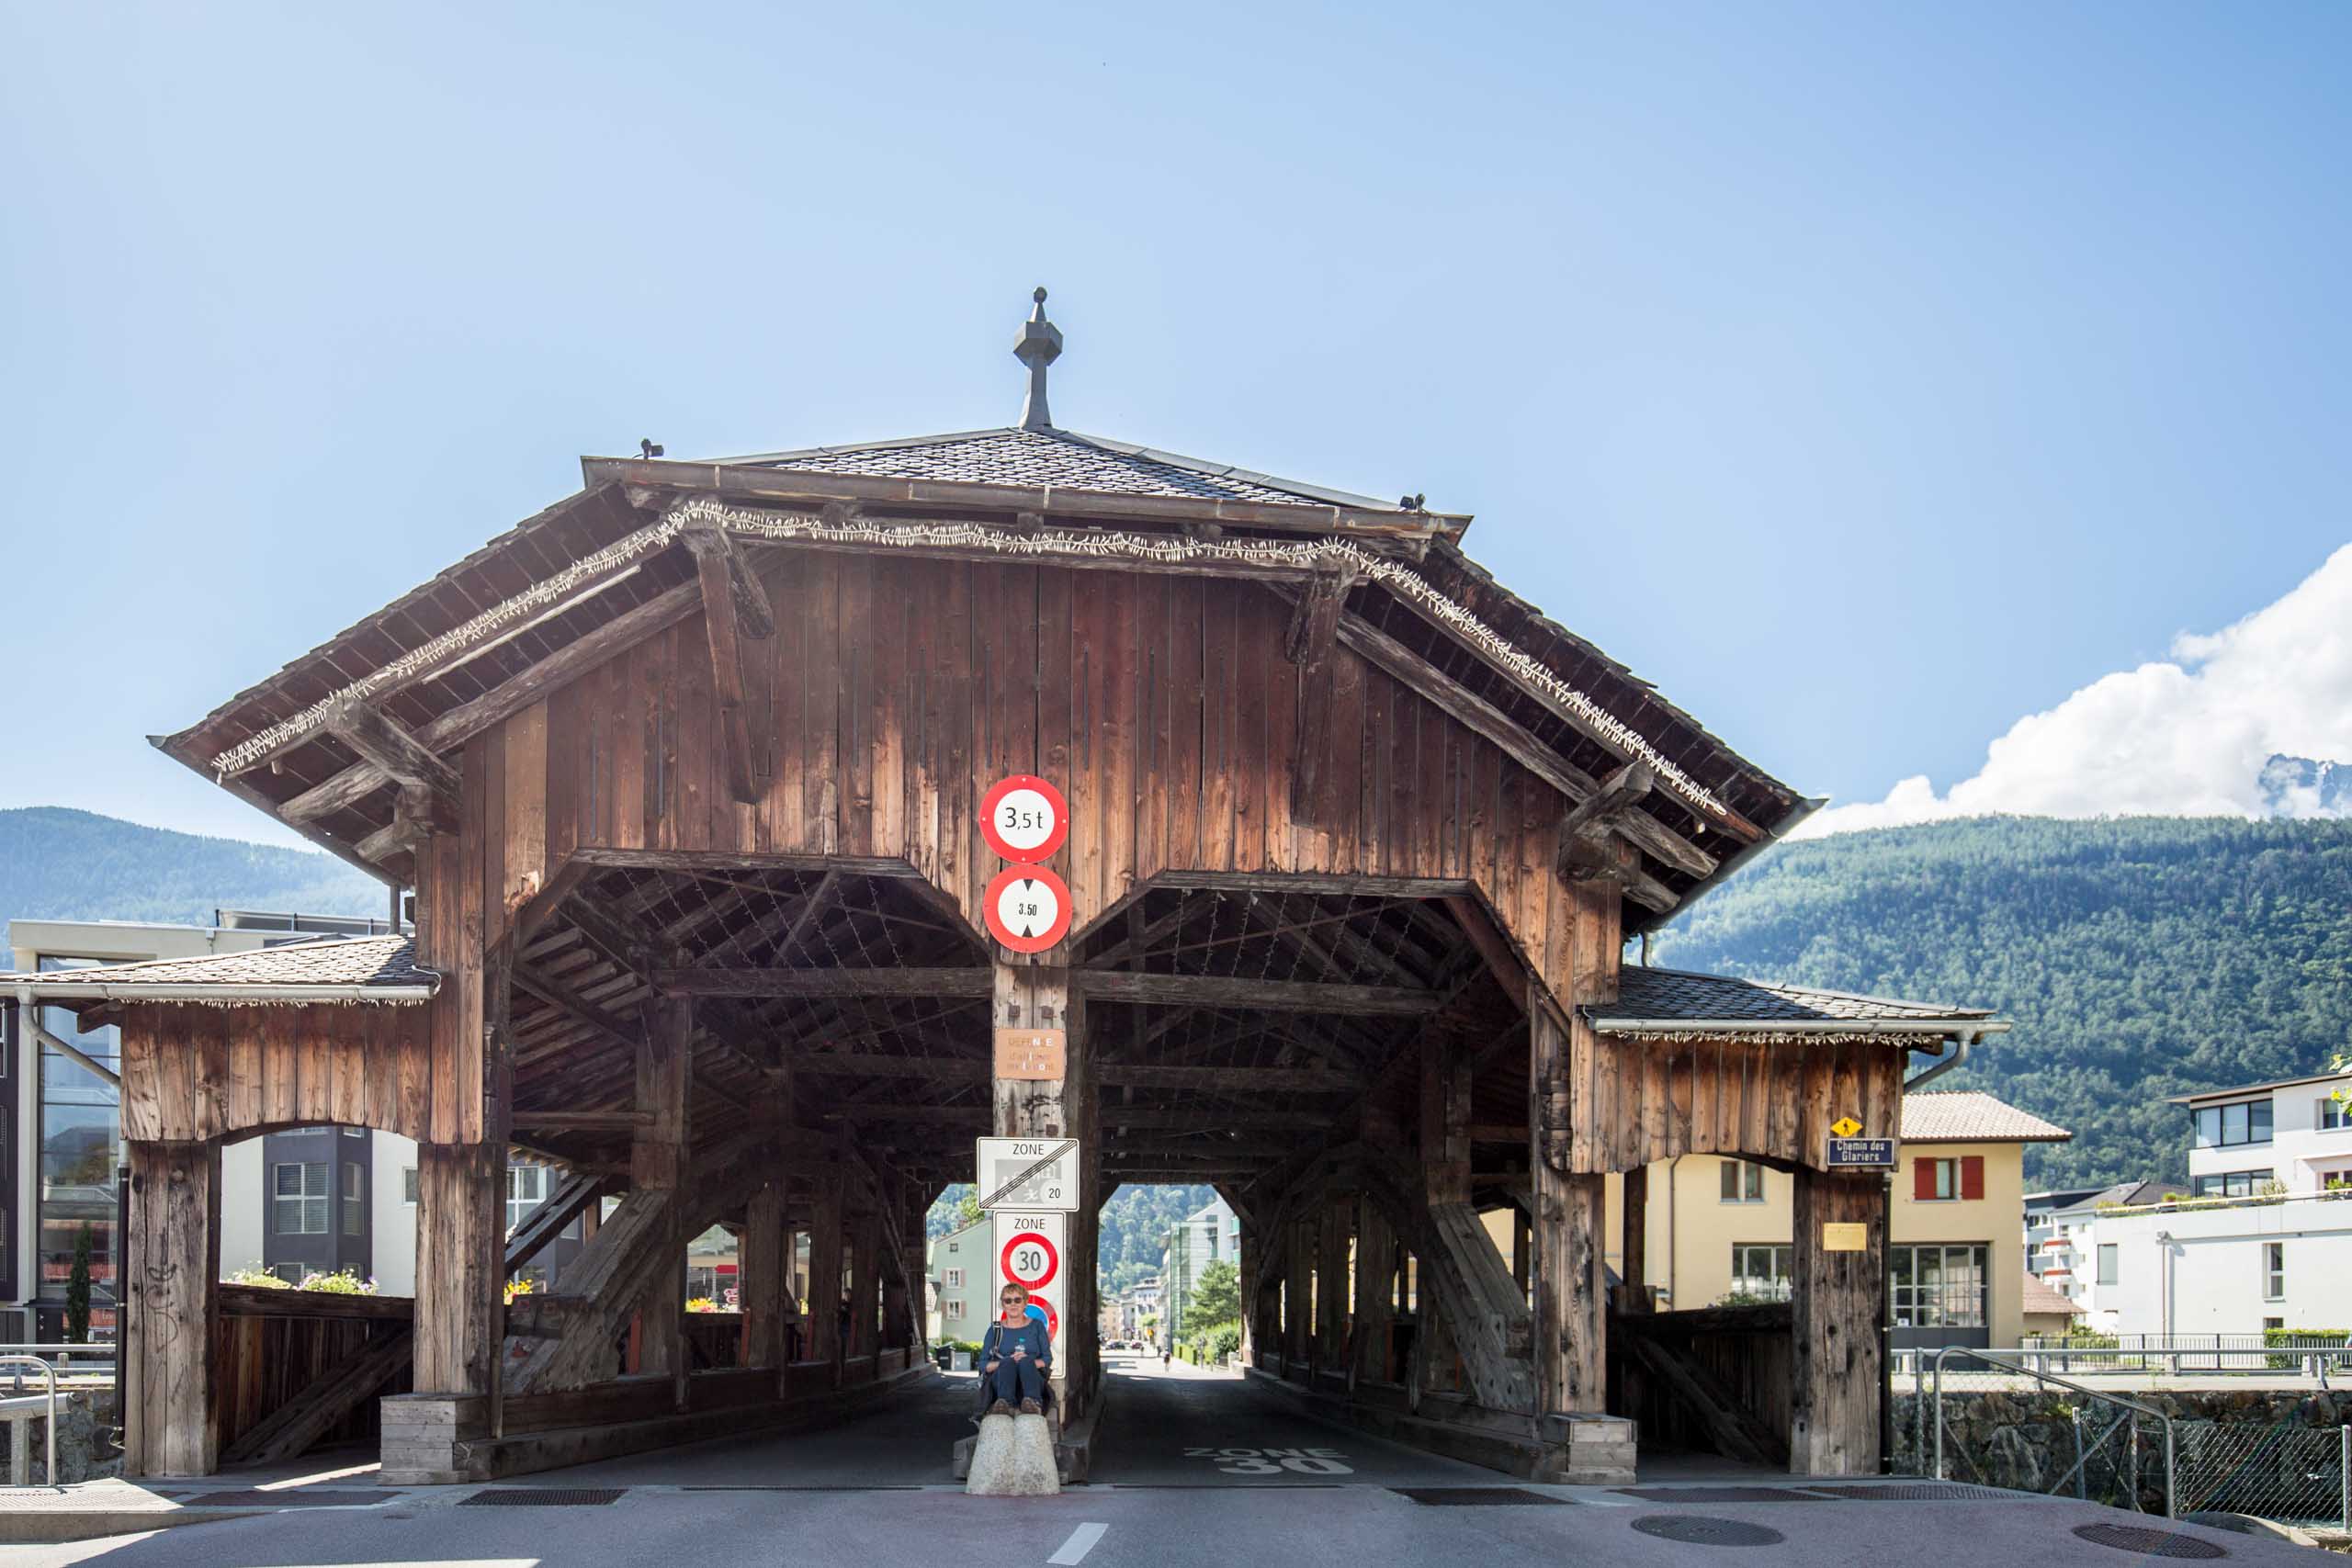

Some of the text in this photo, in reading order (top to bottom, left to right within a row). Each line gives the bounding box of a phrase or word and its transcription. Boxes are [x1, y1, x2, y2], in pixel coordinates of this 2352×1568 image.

[1004, 807, 1044, 830] 3,5 t
[1018, 902, 1037, 917] 3.50
[1012, 1143, 1045, 1156] ZONE
[1837, 1139, 1885, 1151] Chemin des
[1841, 1150, 1880, 1162] Glariers
[1048, 1187, 1061, 1199] 20
[1014, 1217, 1046, 1230] ZONE
[1018, 1250, 1041, 1271] 30
[1182, 1447, 1352, 1459] ZONE
[1213, 1457, 1355, 1475] 30
